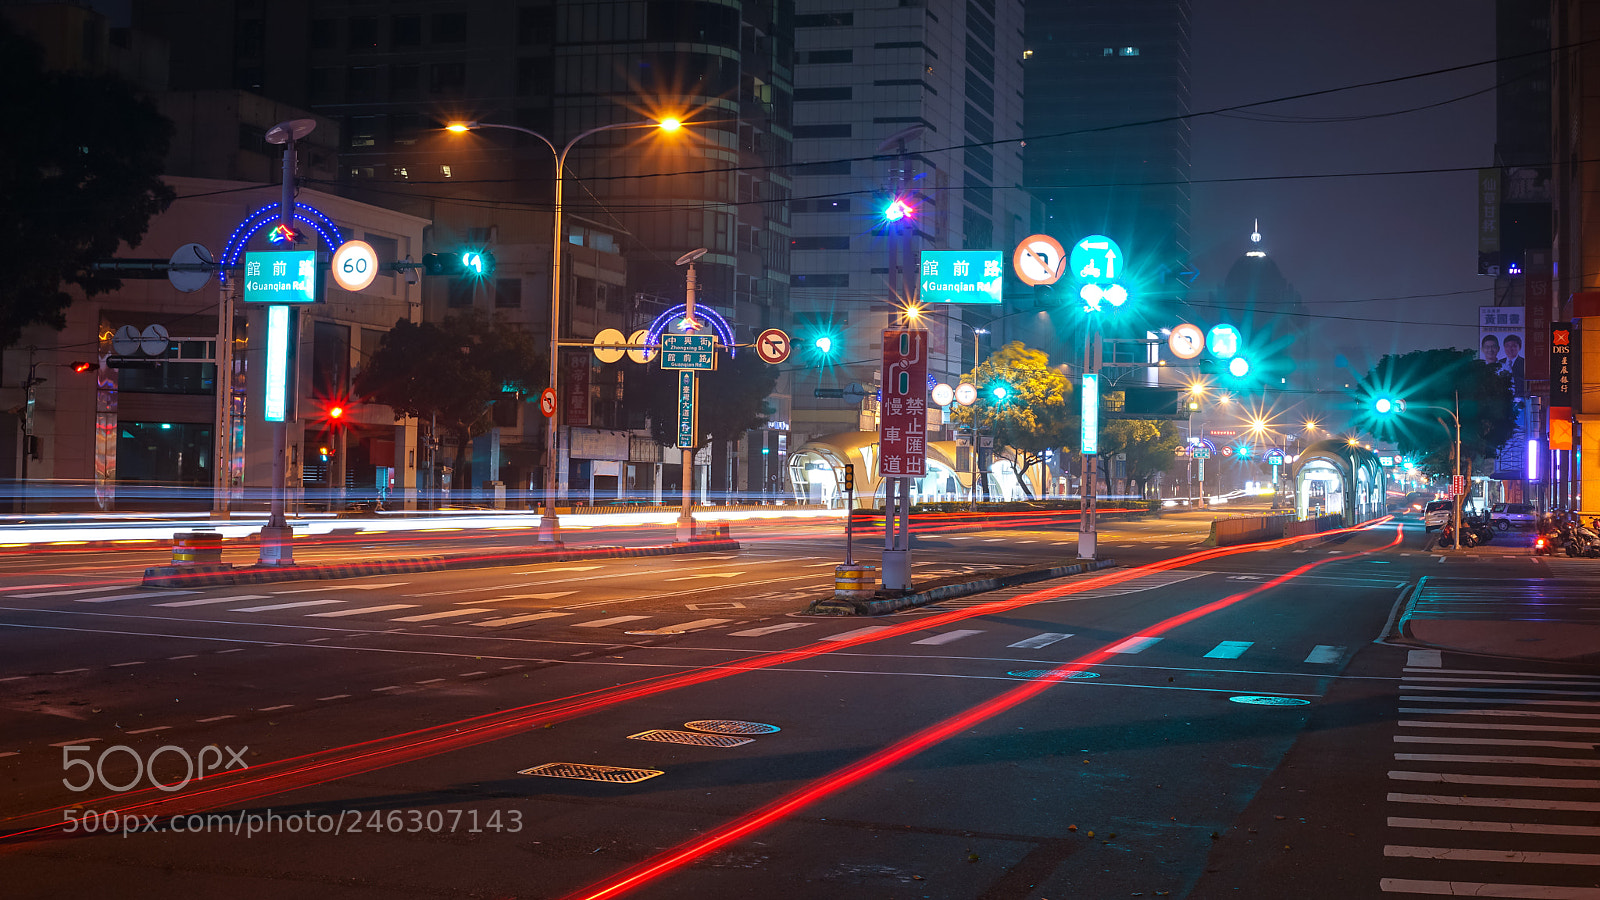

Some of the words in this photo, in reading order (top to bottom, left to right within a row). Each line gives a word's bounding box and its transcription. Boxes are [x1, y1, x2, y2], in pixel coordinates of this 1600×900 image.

[247, 260, 314, 276] 館前路
[343, 258, 367, 273] 60
[923, 260, 1001, 277] 館前路
[252, 281, 291, 292] Guanqian
[929, 281, 975, 293] Guanqian
[668, 336, 708, 346] 中興街
[1552, 346, 1570, 354] DBS
[667, 353, 707, 363] 館前路
[1560, 356, 1569, 393] 星展銀行
[681, 385, 691, 433] 臺灣大道二段
[884, 397, 903, 473] 慢車道
[905, 397, 924, 474] 禁止匯出
